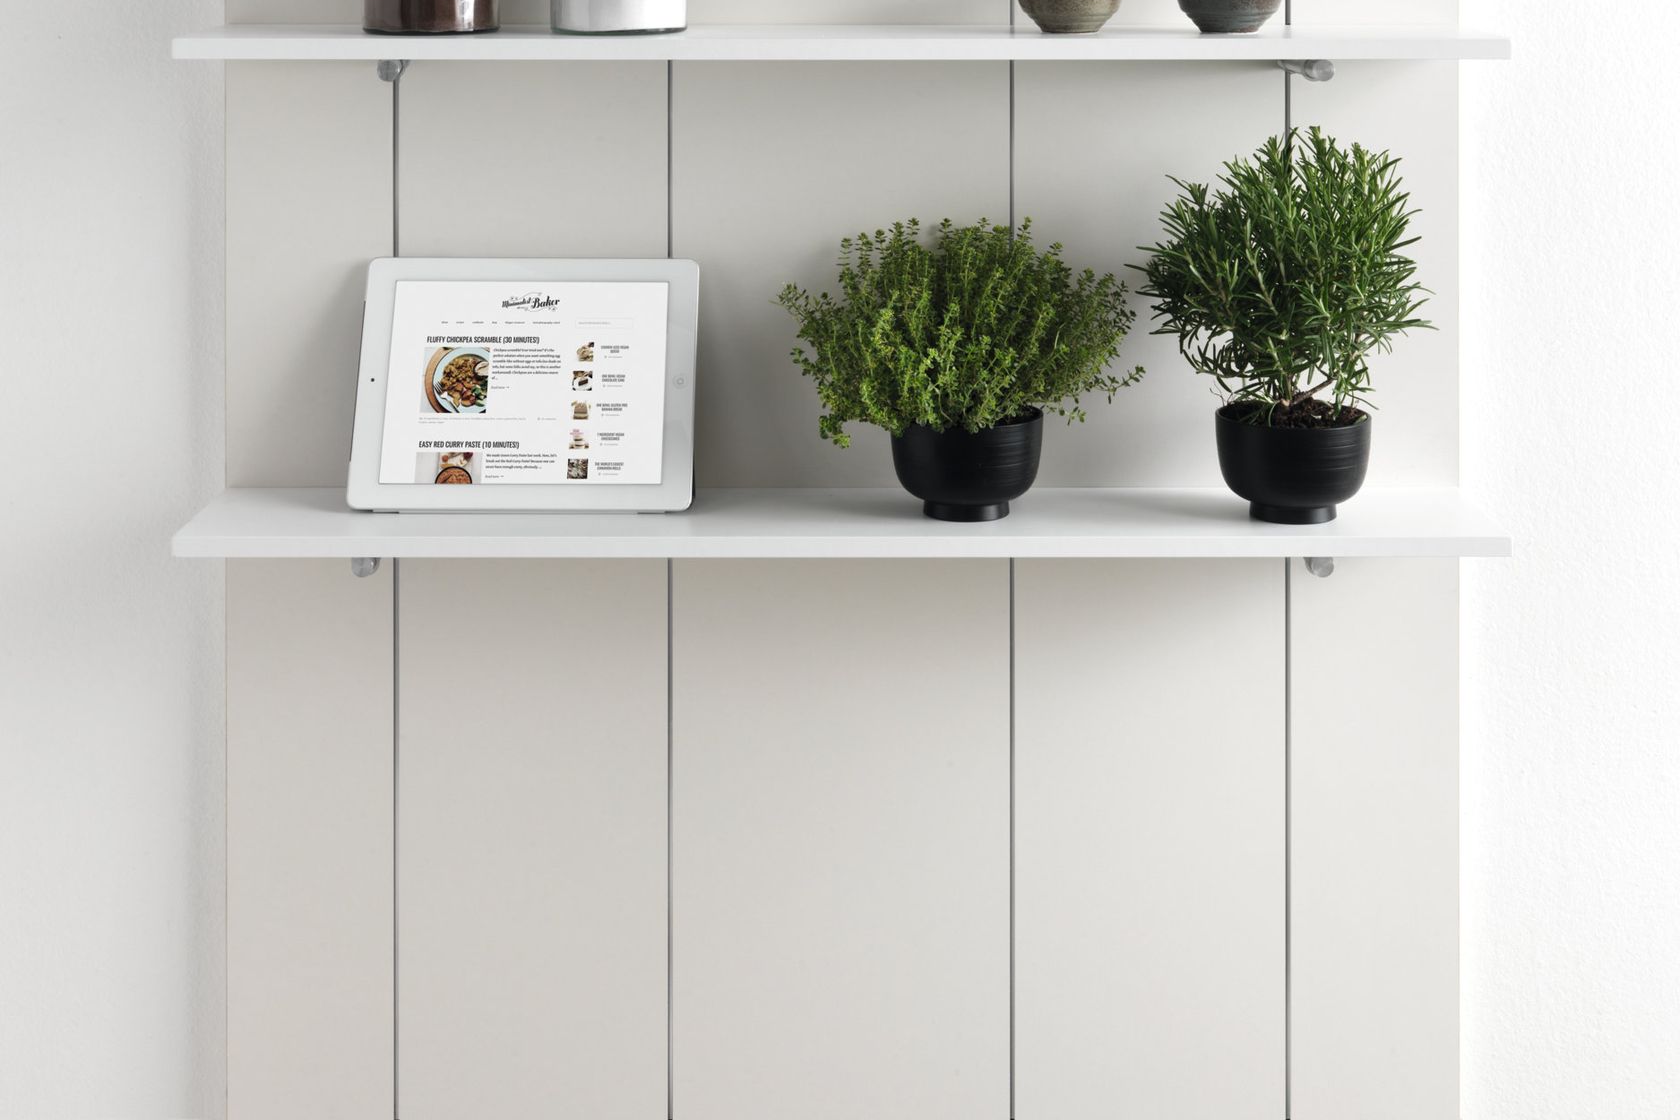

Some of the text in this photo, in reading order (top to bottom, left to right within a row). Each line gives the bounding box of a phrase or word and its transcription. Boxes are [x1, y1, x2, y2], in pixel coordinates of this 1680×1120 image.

[532, 295, 560, 309] Baker
[426, 336, 446, 344] FLUFFY
[446, 336, 473, 344] CHICKPEA
[473, 336, 502, 344] SCRAMBLE
[502, 336, 513, 345] (30
[464, 441, 481, 449] PASTE
[481, 441, 492, 449] (10
[492, 441, 520, 450] MINUTES!)
